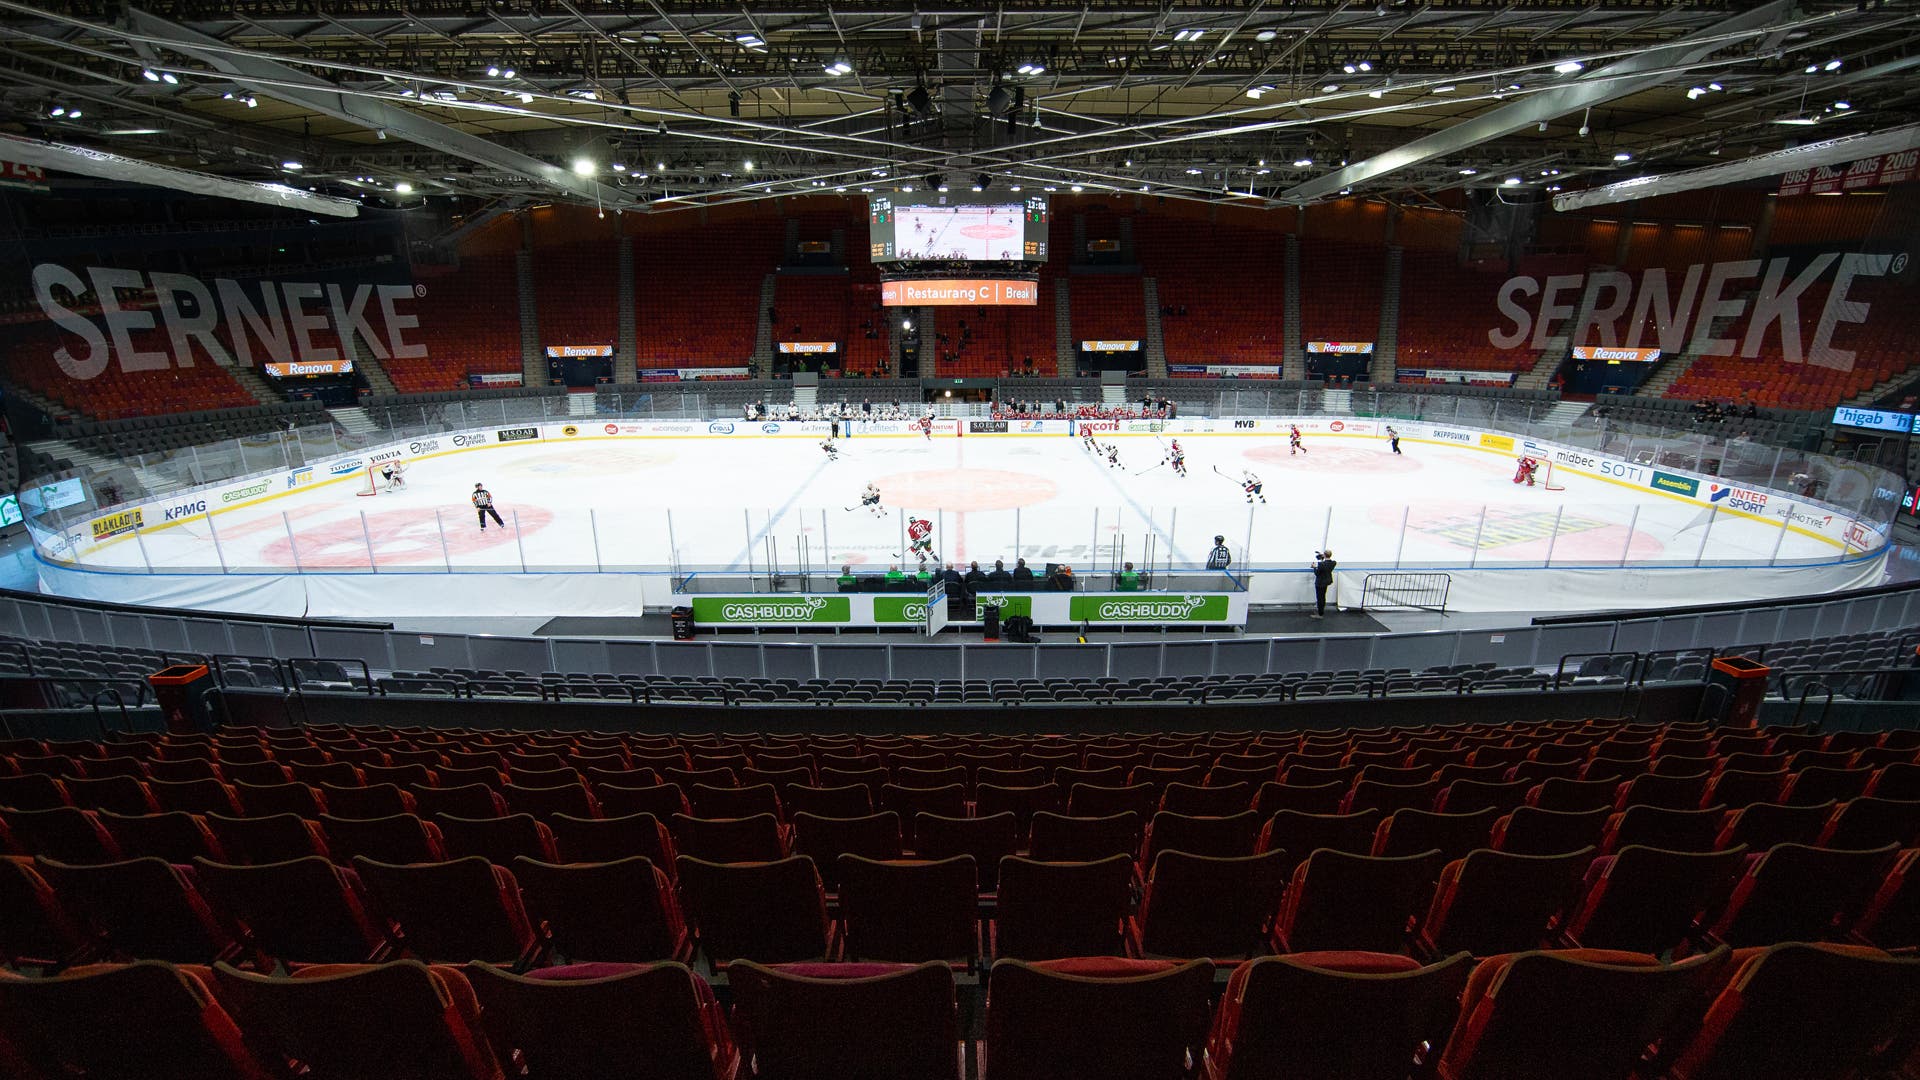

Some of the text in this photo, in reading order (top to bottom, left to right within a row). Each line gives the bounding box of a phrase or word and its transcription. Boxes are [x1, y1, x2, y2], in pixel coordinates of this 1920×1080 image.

[1847, 157, 1881, 175] 2005
[1883, 151, 1919, 171] 2016
[1782, 170, 1810, 185] 1965
[907, 287, 976, 302] Restaurang
[979, 286, 989, 298] C
[1006, 287, 1030, 299] Break
[564, 345, 597, 356] Renova
[794, 343, 823, 352] Renova
[1096, 342, 1125, 351] Renova
[1323, 343, 1357, 353] Renova
[1593, 349, 1638, 360] Renova
[289, 362, 333, 375] Renova
[1234, 420, 1255, 428] MVB
[1843, 410, 1883, 426] higab
[1433, 430, 1470, 441] SKEPPSVIKEN
[370, 450, 402, 464] VOLVIA
[1557, 451, 1595, 467] midbec
[330, 460, 363, 472] TUVEON
[1600, 461, 1643, 481] SOTI
[1657, 477, 1692, 491] Assemblin
[222, 484, 268, 502] CASHBUDDY
[1732, 488, 1768, 505] INTER
[165, 500, 207, 520] KPMG
[1728, 498, 1766, 514] SPORT
[92, 511, 142, 535] BLÅKLÄDR
[913, 523, 928, 534] 20
[724, 605, 813, 619] CASHBUDDY
[1102, 605, 1190, 617] CASHBUDDY
